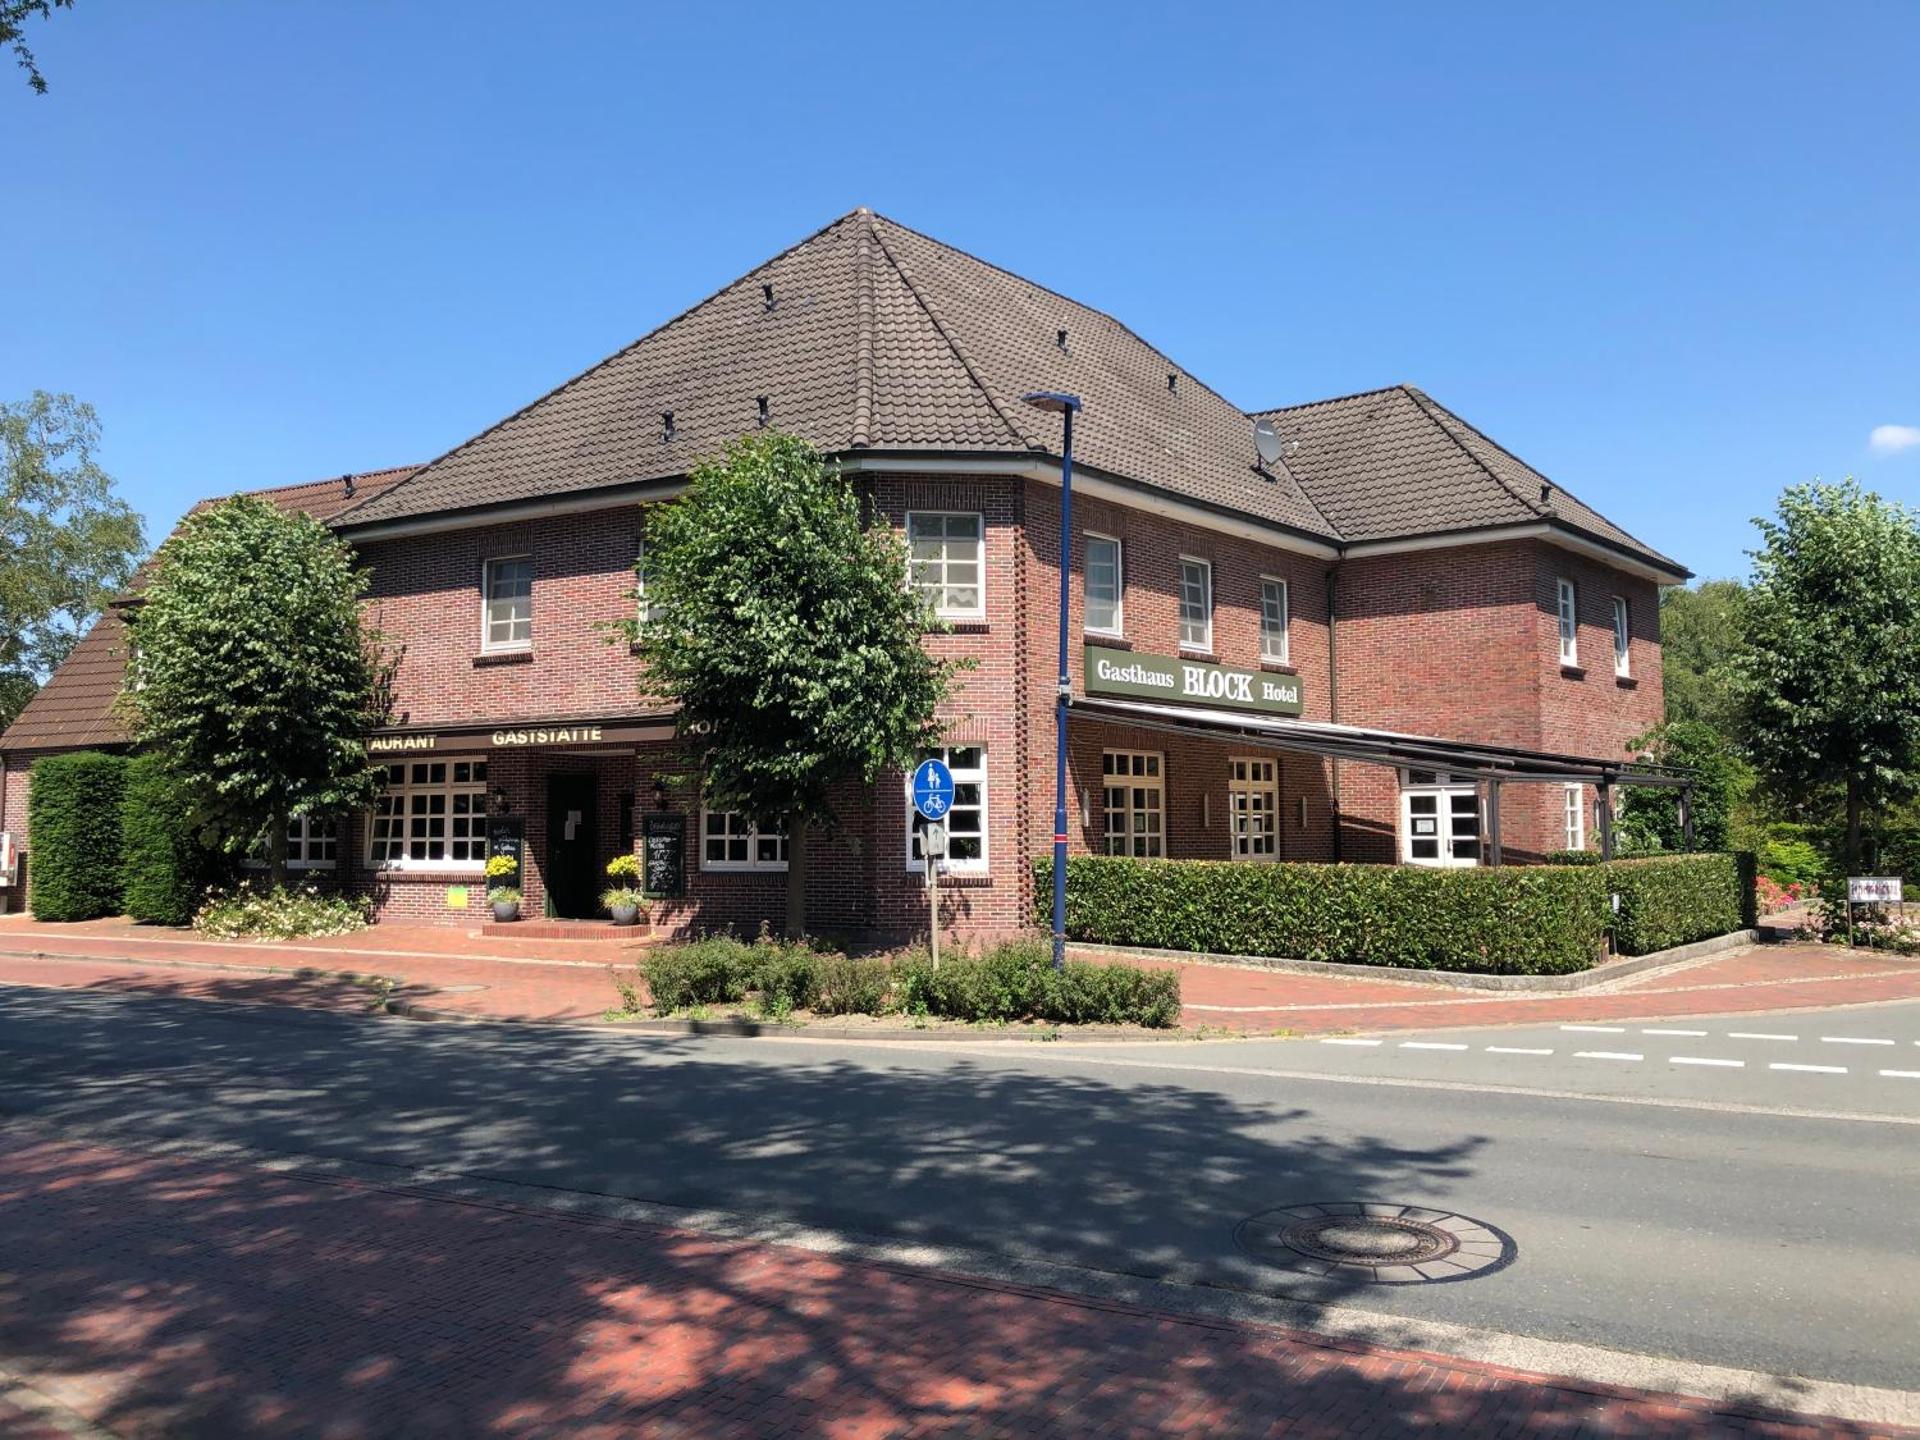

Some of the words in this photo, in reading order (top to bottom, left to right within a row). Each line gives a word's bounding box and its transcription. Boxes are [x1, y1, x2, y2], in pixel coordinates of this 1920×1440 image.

[1097, 659, 1175, 688] Gasthaus
[1182, 666, 1254, 702] BLOCK
[1262, 682, 1299, 704] Hotel
